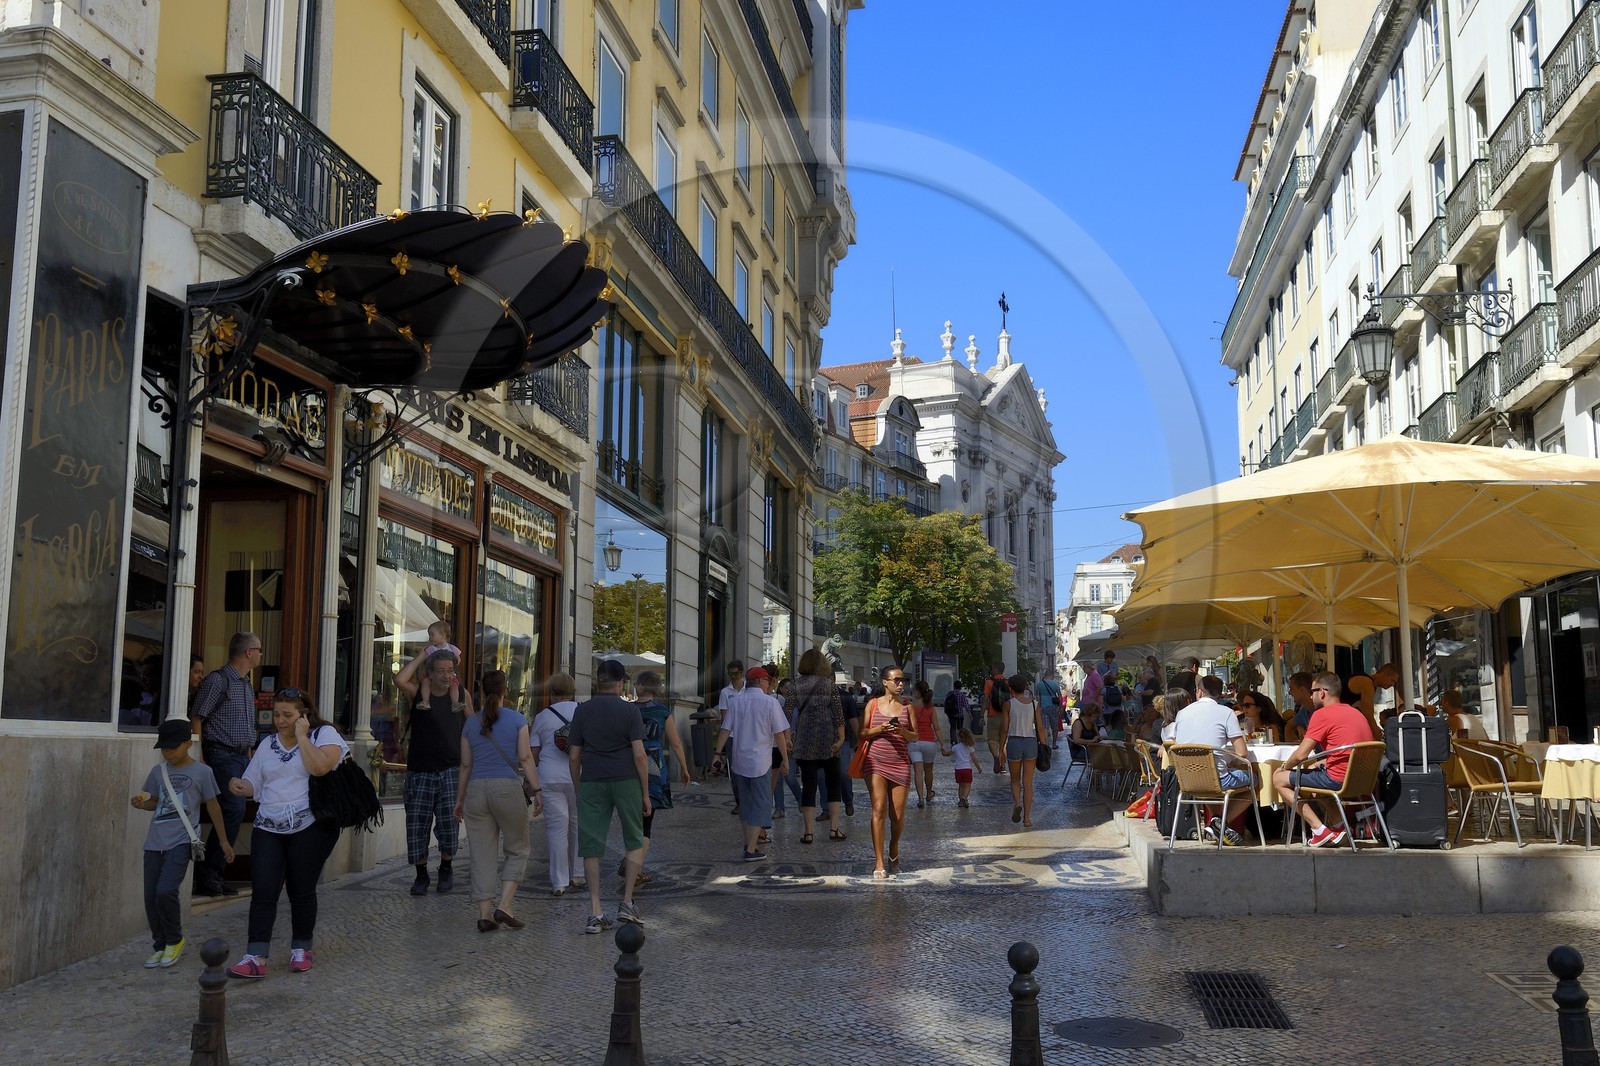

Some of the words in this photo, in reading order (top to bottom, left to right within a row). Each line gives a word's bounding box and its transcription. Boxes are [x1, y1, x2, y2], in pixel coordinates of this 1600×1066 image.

[27, 312, 126, 450] PARIS
[52, 454, 103, 489] EM
[385, 443, 472, 513] NOVIDADES
[392, 388, 465, 434] ARIS
[503, 435, 571, 496] LISBOA
[12, 497, 117, 658] LISBOA
